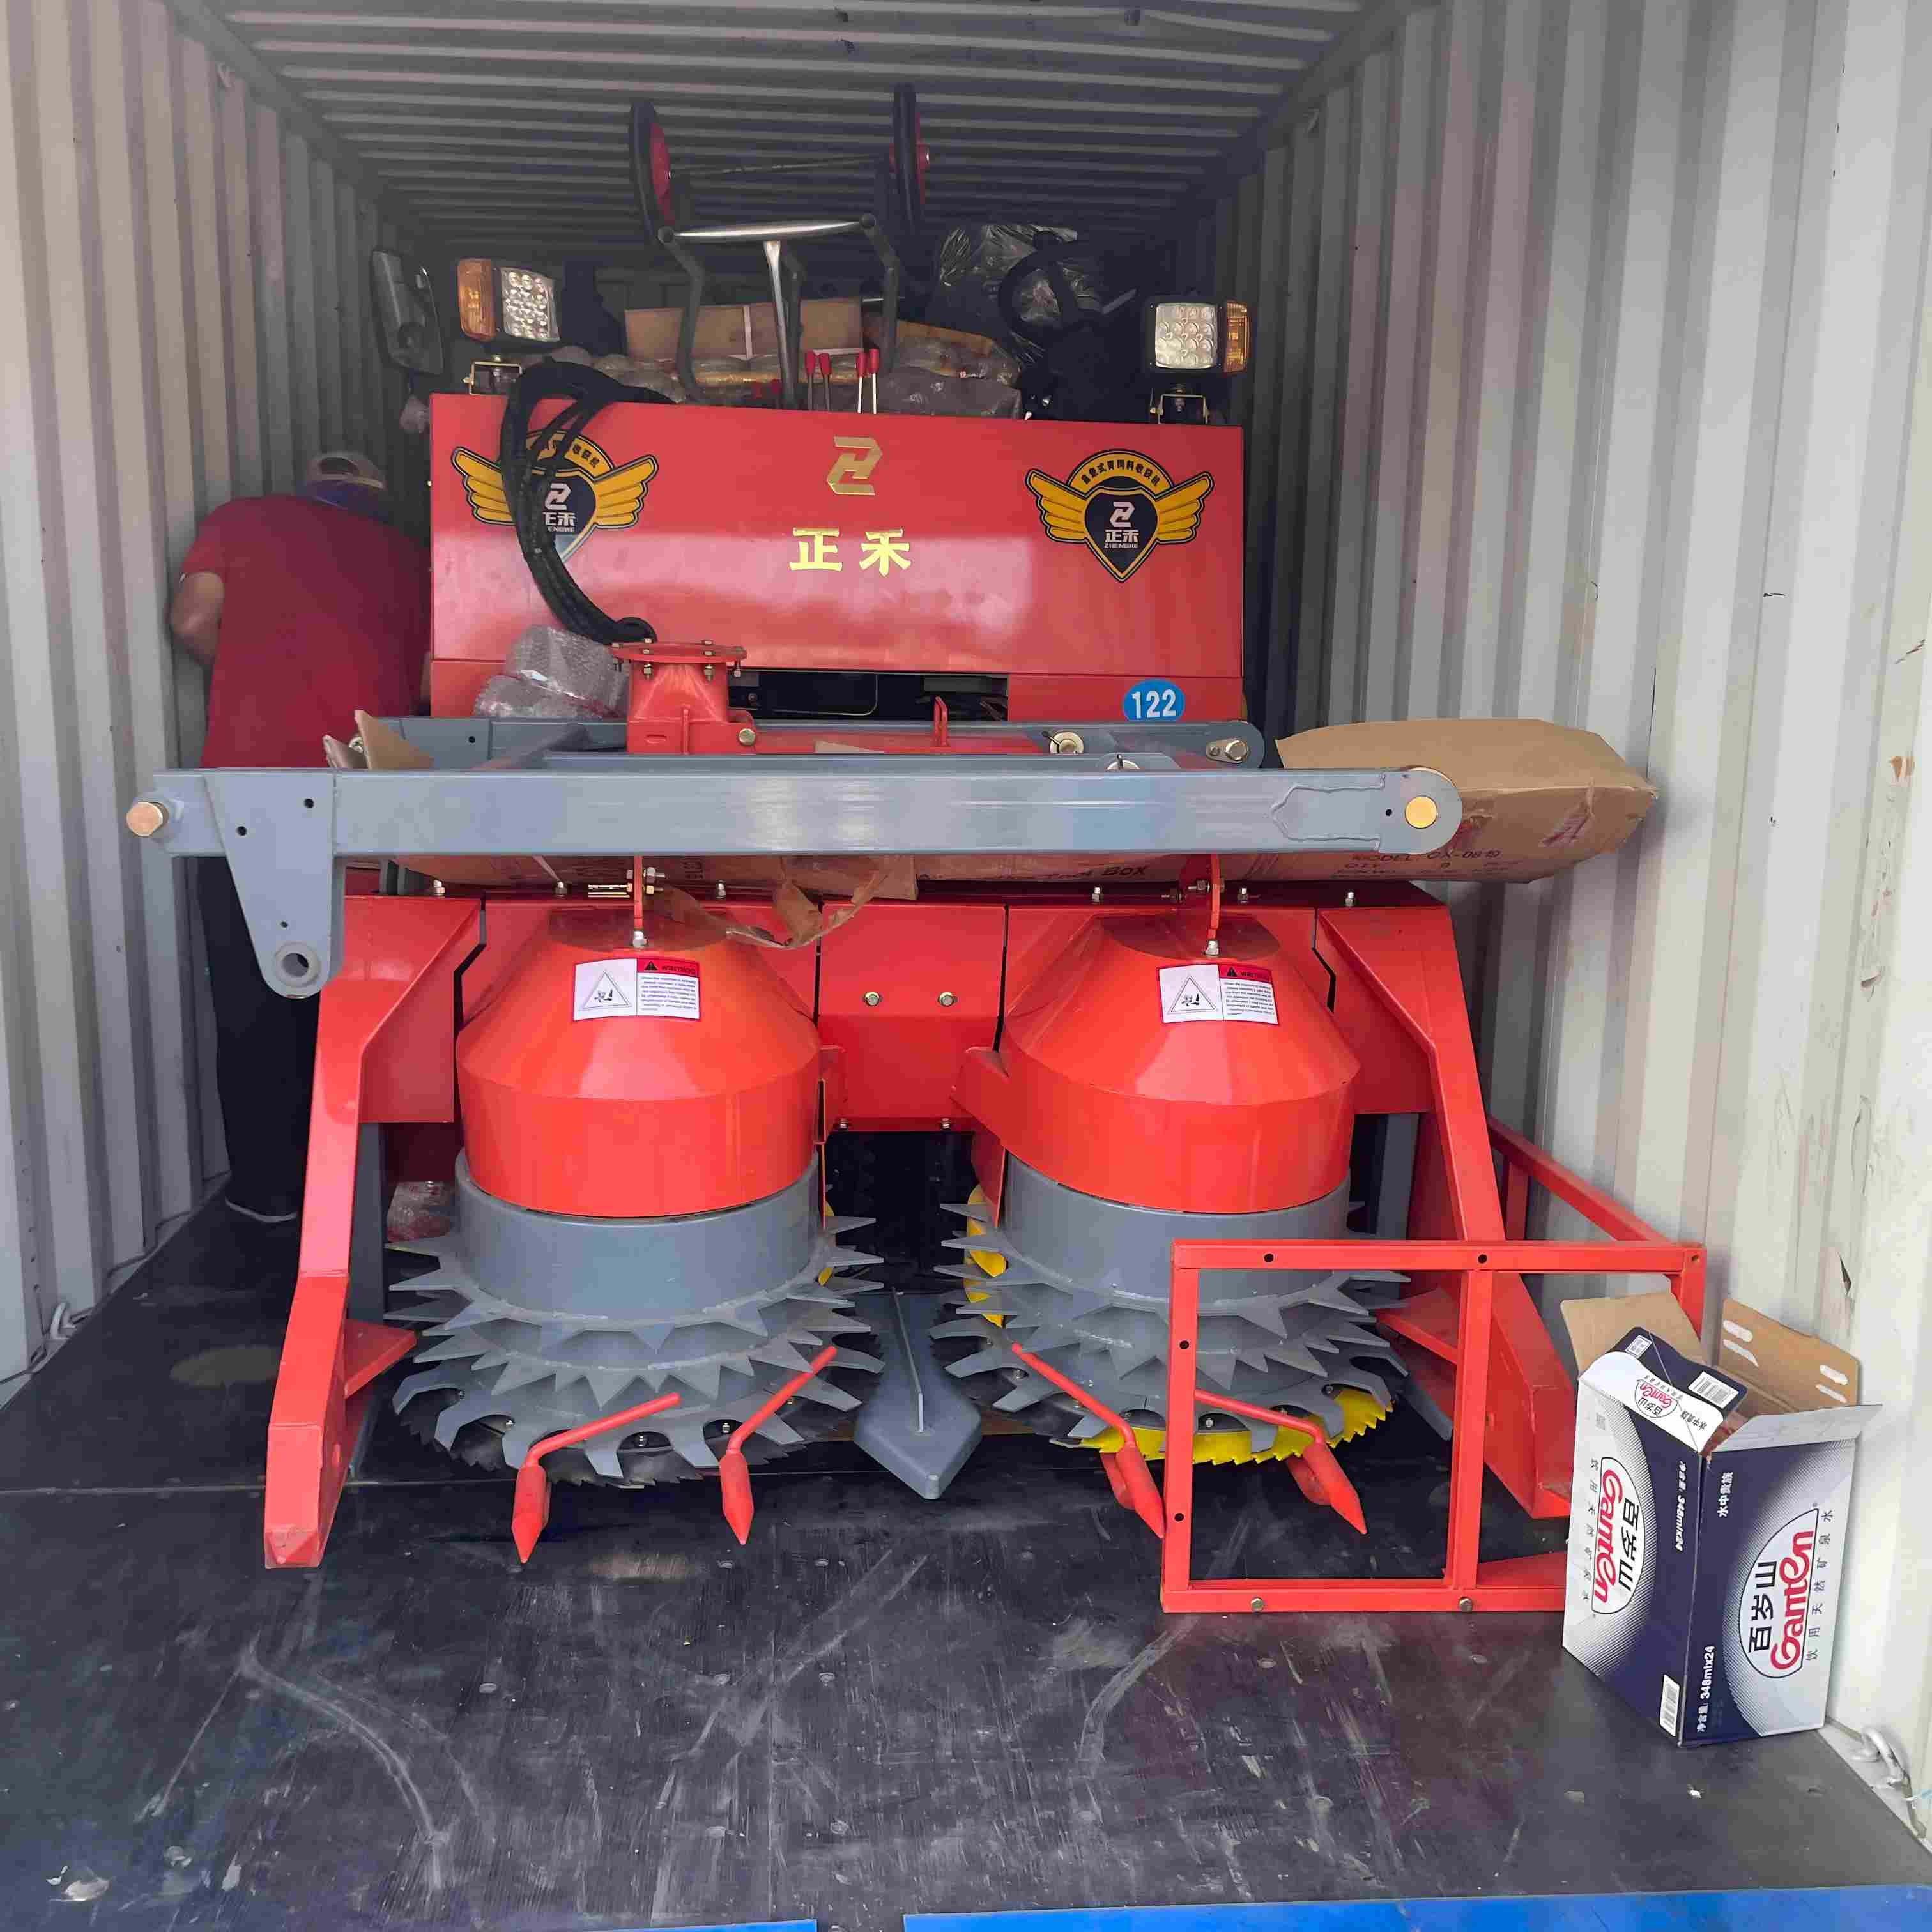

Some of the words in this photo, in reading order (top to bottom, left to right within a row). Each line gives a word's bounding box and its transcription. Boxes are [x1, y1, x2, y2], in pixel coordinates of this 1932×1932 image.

[789, 527, 912, 577] 正禾
[1104, 529, 1140, 542] 正禾
[1132, 689, 1177, 719] 122
[1618, 1497, 1639, 1592] 百岁山
[1748, 1560, 1777, 1653] 百岁山
